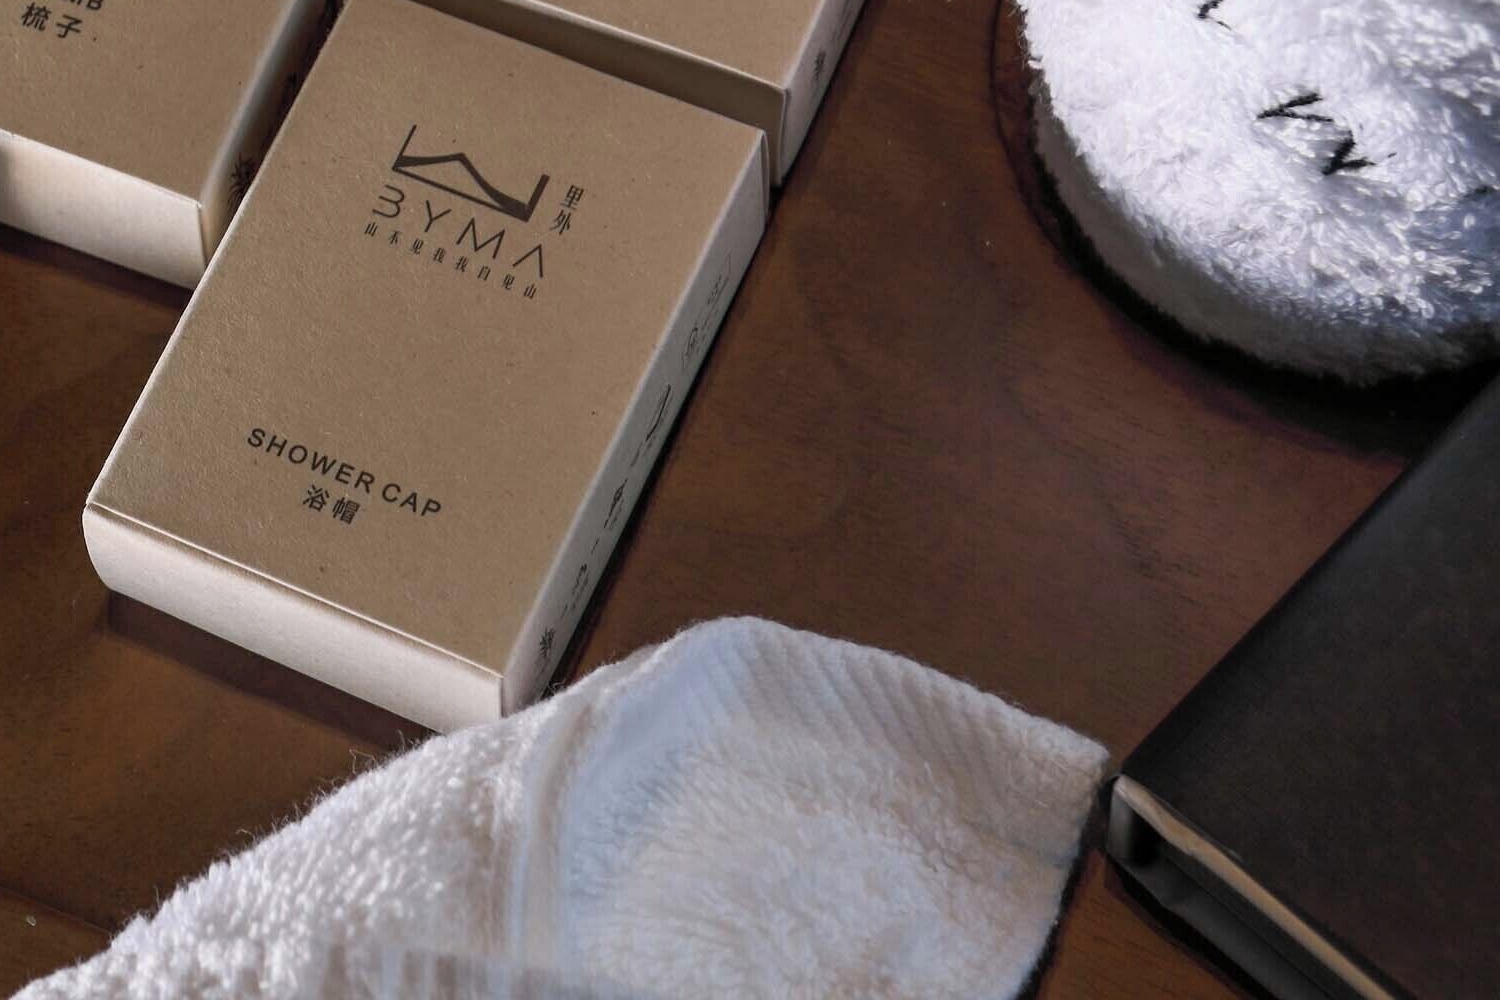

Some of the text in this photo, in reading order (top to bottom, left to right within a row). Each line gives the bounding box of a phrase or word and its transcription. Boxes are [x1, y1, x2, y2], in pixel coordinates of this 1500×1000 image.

[21, 2, 83, 38] 梳子
[550, 184, 585, 235] 里外
[363, 222, 538, 300] 山不见我我自见山
[247, 428, 442, 517] SHOWER CAP
[303, 484, 360, 524] 浴帽
